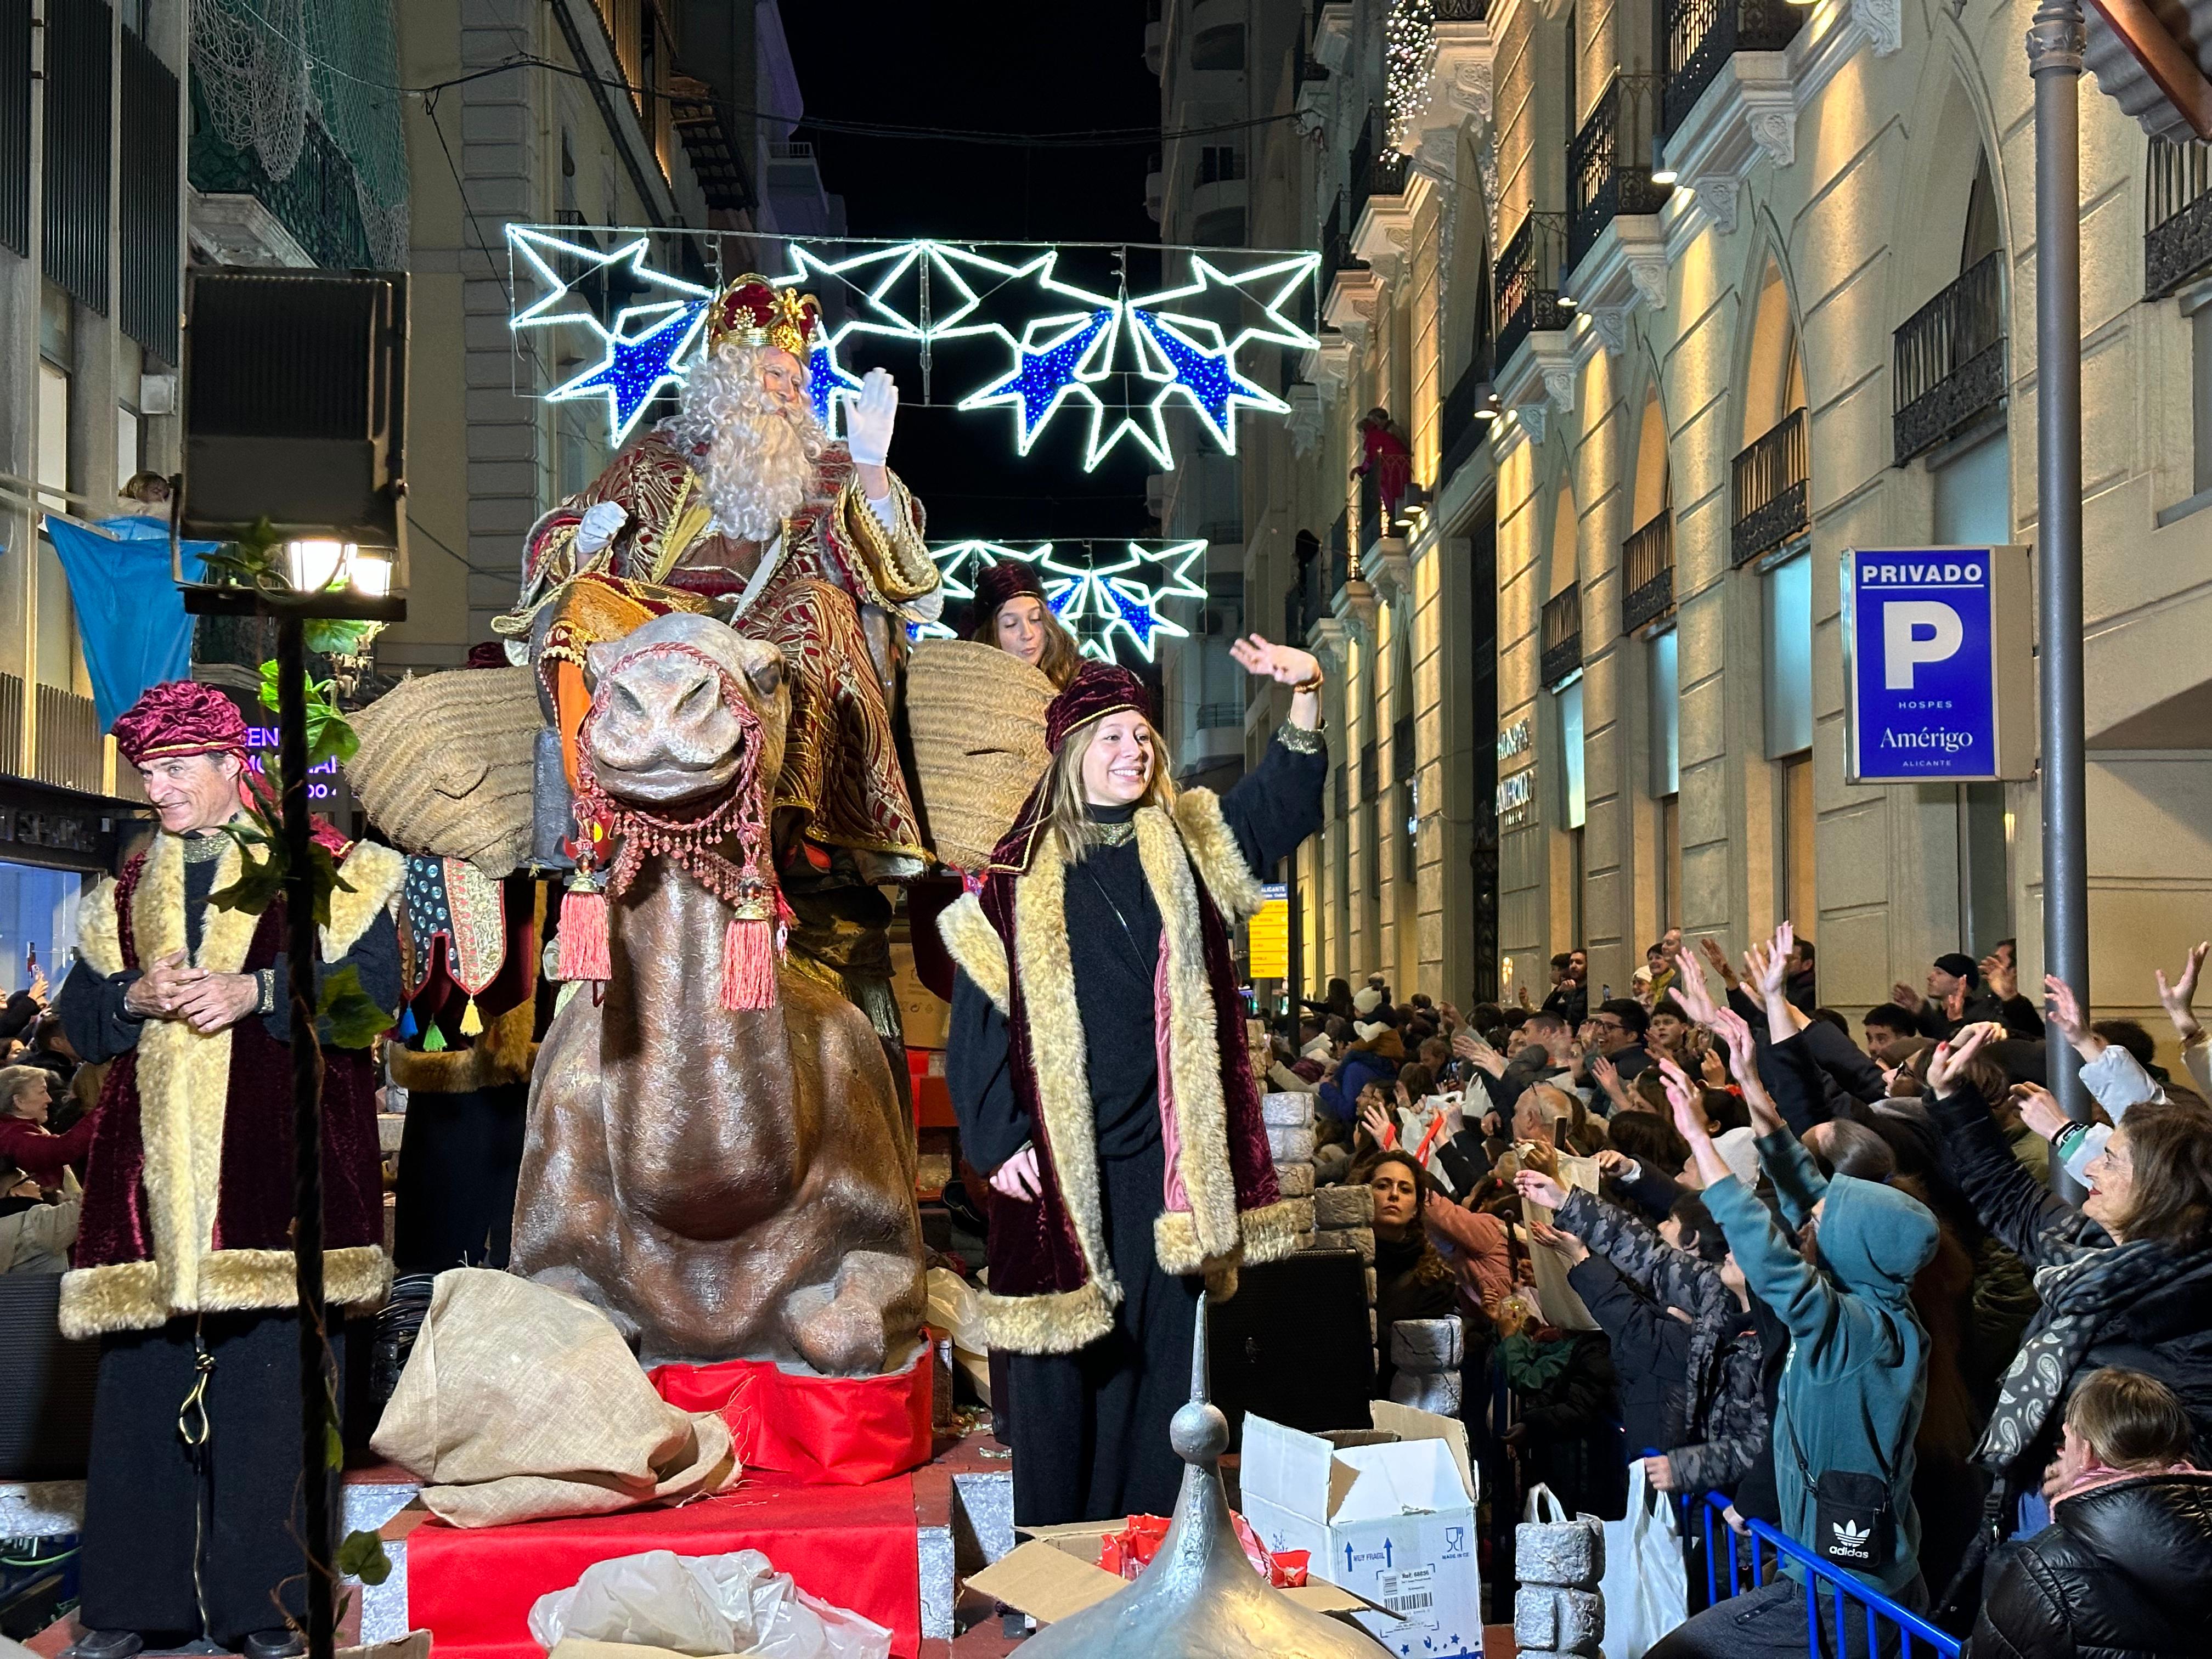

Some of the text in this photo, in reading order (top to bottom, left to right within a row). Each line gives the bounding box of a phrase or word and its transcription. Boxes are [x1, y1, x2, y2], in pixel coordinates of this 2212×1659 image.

[1862, 564, 1982, 583] PRIVADO
[1883, 600, 1964, 690] P
[1898, 701, 1953, 709] HOSPES
[1880, 727, 1973, 752] Amérigo
[1829, 1545, 1869, 1559] adidas
